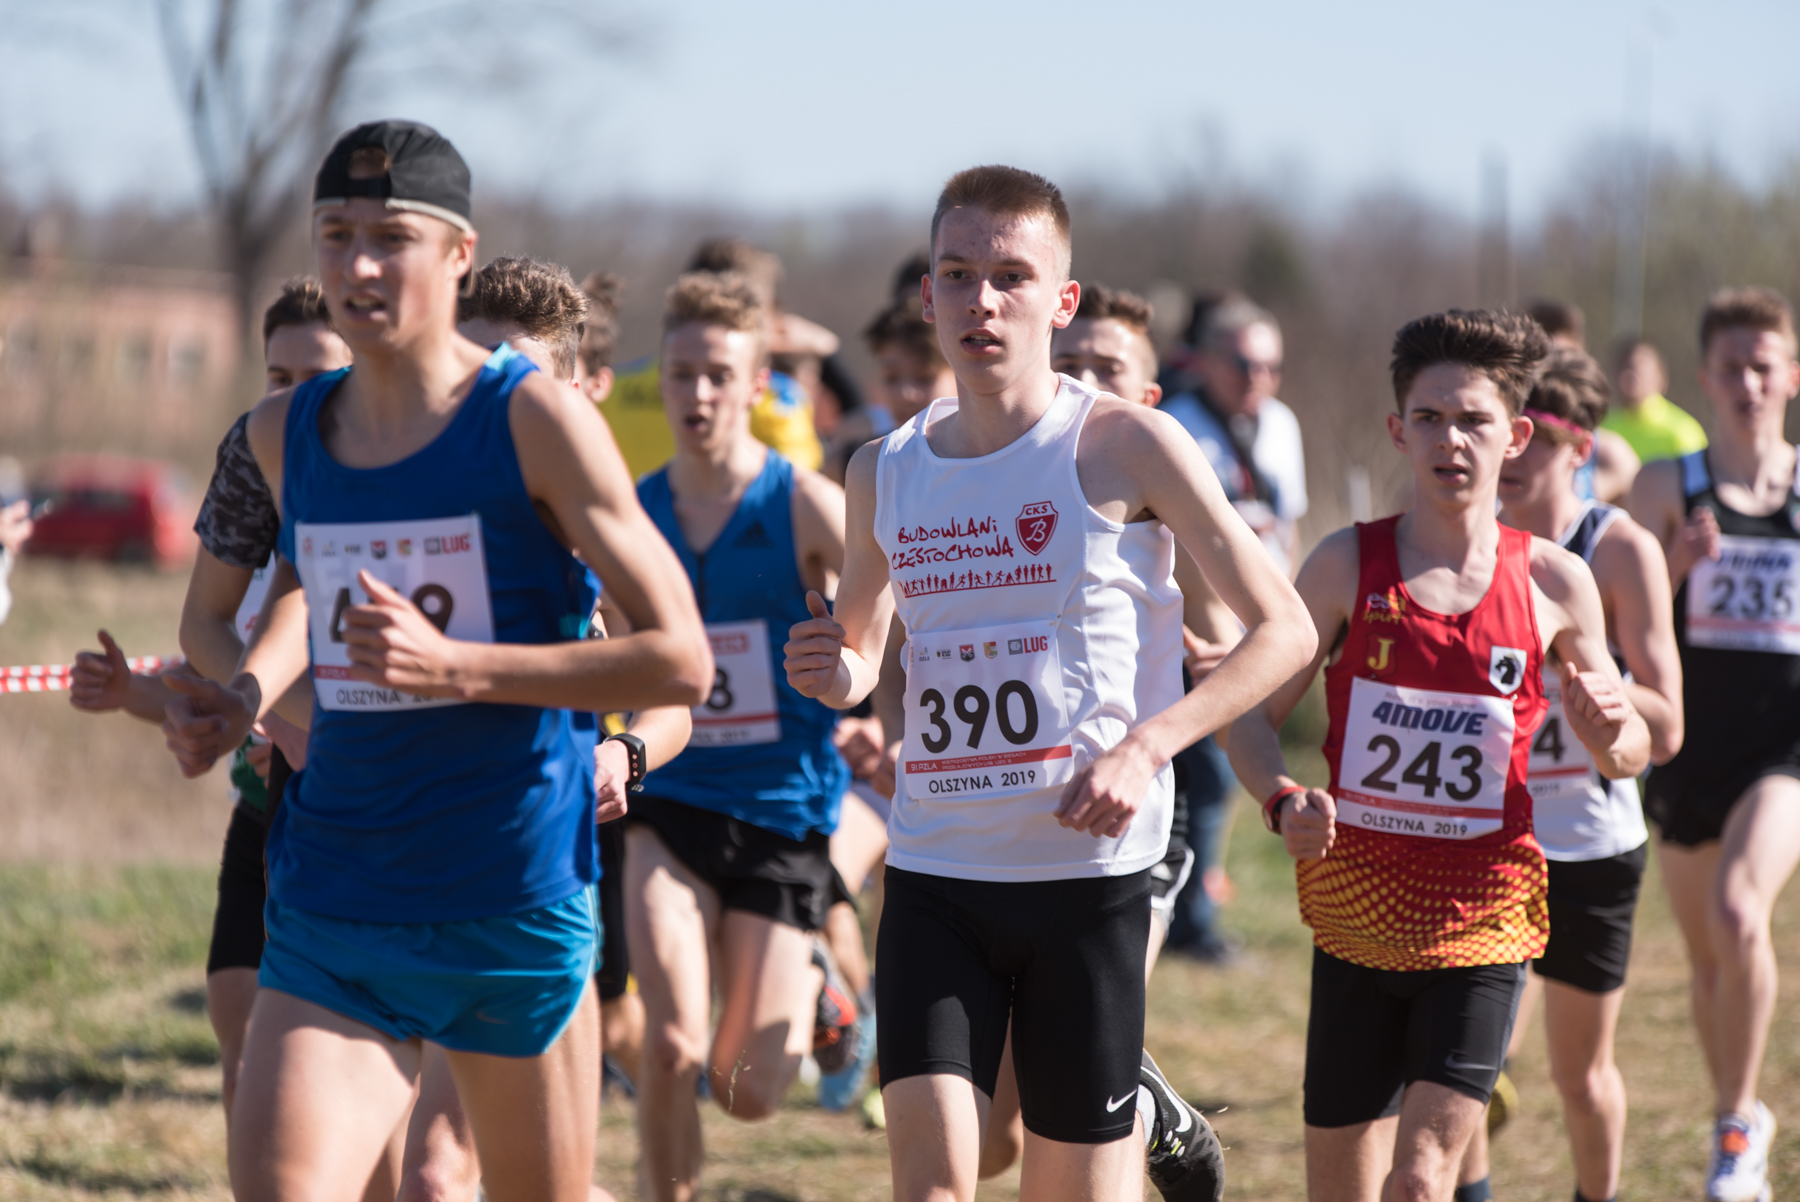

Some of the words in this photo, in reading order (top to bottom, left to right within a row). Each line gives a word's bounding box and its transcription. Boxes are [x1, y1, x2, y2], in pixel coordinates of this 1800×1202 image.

[1025, 505, 1048, 515] CKS
[1025, 518, 1047, 542] B
[441, 534, 471, 554] LUG
[1709, 573, 1793, 618] 235
[1023, 635, 1048, 653] LUG
[1368, 637, 1394, 670] J
[336, 689, 401, 705] OLSZYNA
[920, 680, 1038, 753] 390
[1361, 734, 1483, 802] 243
[929, 775, 993, 793] OLSZYNA
[1001, 770, 1035, 786] 2019
[1361, 812, 1425, 833] OLSZYNA
[1434, 822, 1468, 836] 2019
